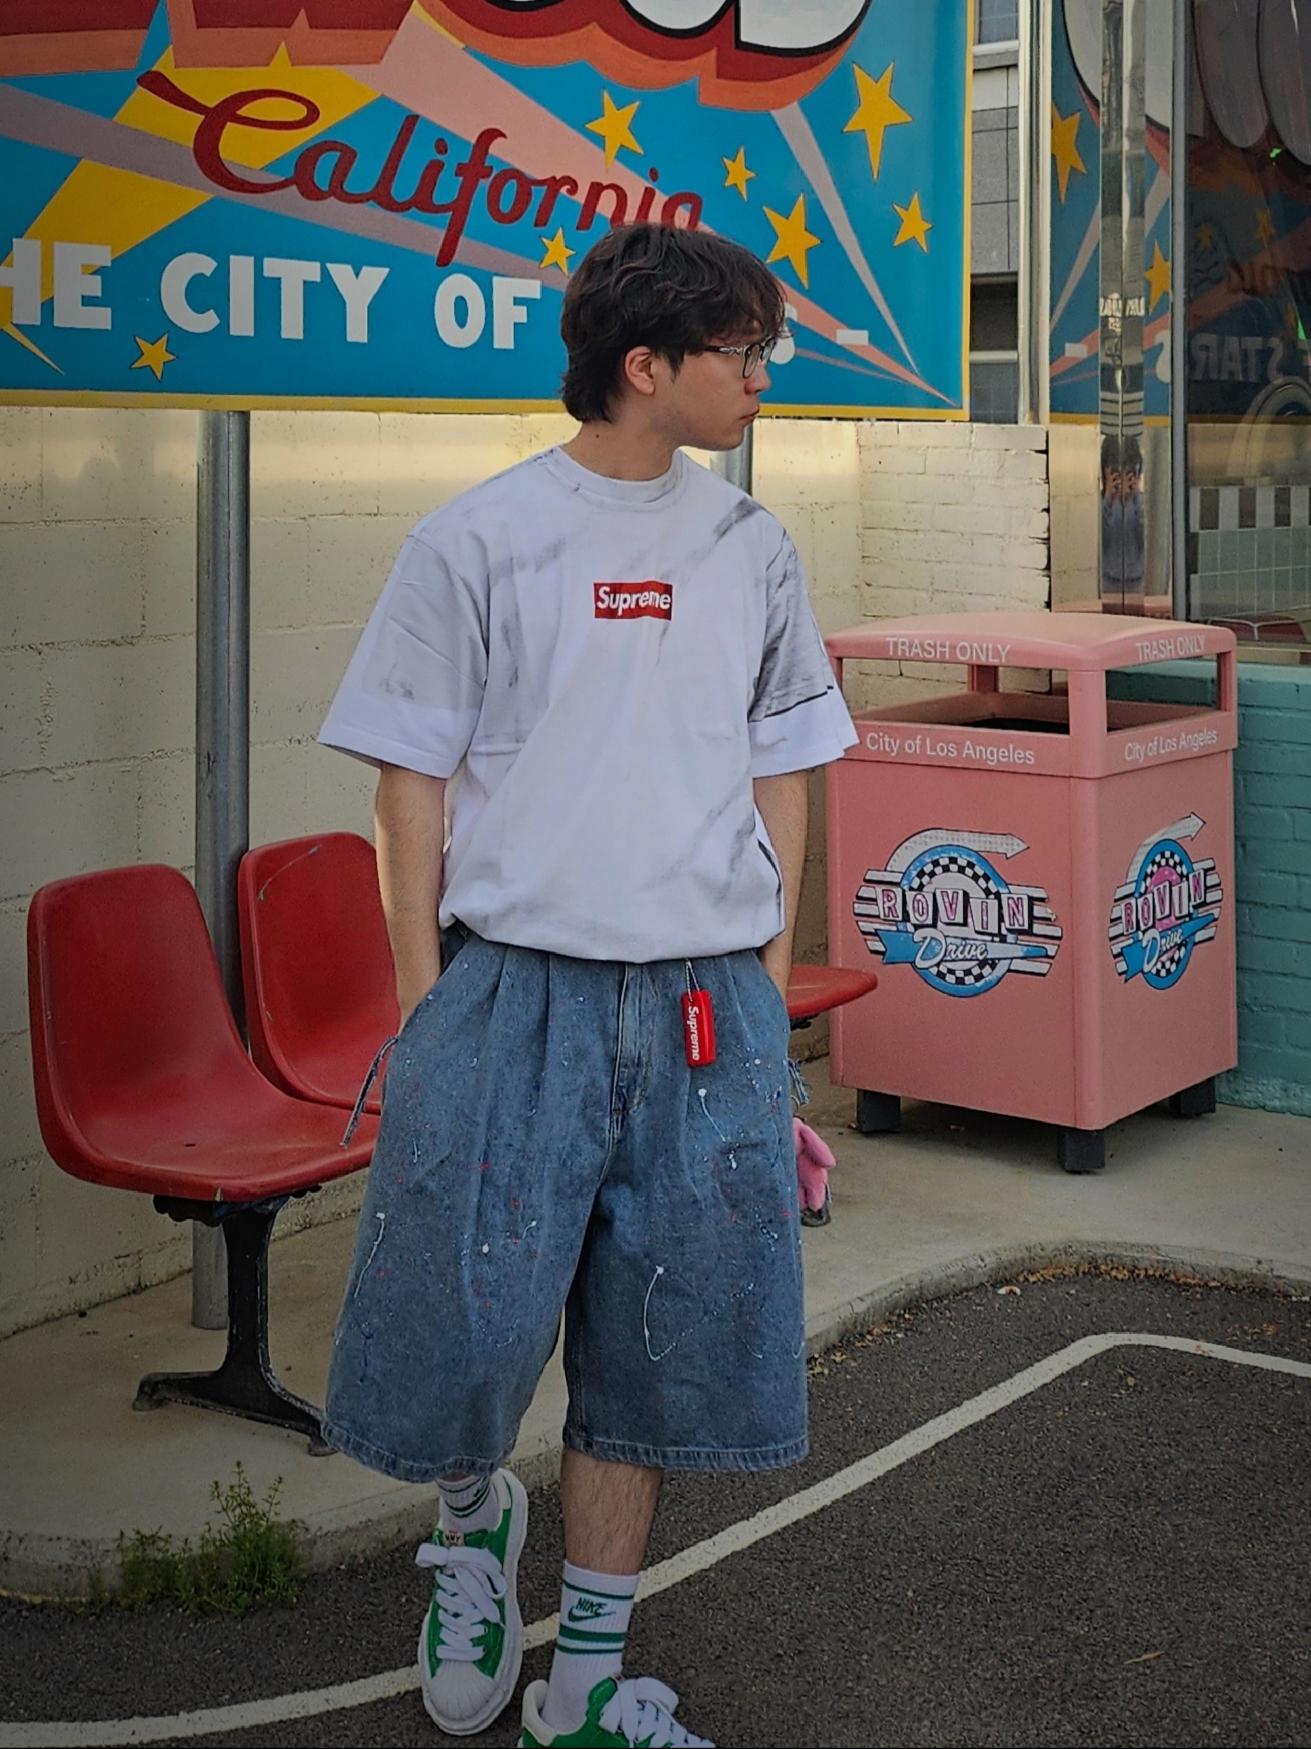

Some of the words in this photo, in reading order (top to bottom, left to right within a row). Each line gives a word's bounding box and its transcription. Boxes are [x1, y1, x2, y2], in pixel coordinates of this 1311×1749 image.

[160, 252, 390, 344] CITY
[434, 273, 542, 349] OF
[596, 586, 672, 616] Supreme
[885, 636, 950, 660] TRASH
[955, 641, 1011, 663] ONLY
[1134, 638, 1175, 661] TRASH
[1176, 634, 1205, 655] ONLY
[866, 732, 900, 756] City
[904, 735, 922, 754] of
[926, 738, 957, 757] Los
[962, 741, 1035, 765] Angeles
[1124, 741, 1145, 763] City
[1147, 736, 1159, 756] of
[1159, 737, 1178, 754] Los
[1179, 728, 1218, 752] Angeles
[879, 888, 1027, 932] ROVIN
[1123, 870, 1203, 934] ROVIN
[913, 927, 989, 969] Drive
[1142, 928, 1183, 973] Drive
[686, 1005, 700, 1061] Supreme
[575, 1596, 607, 1617] NIKE
